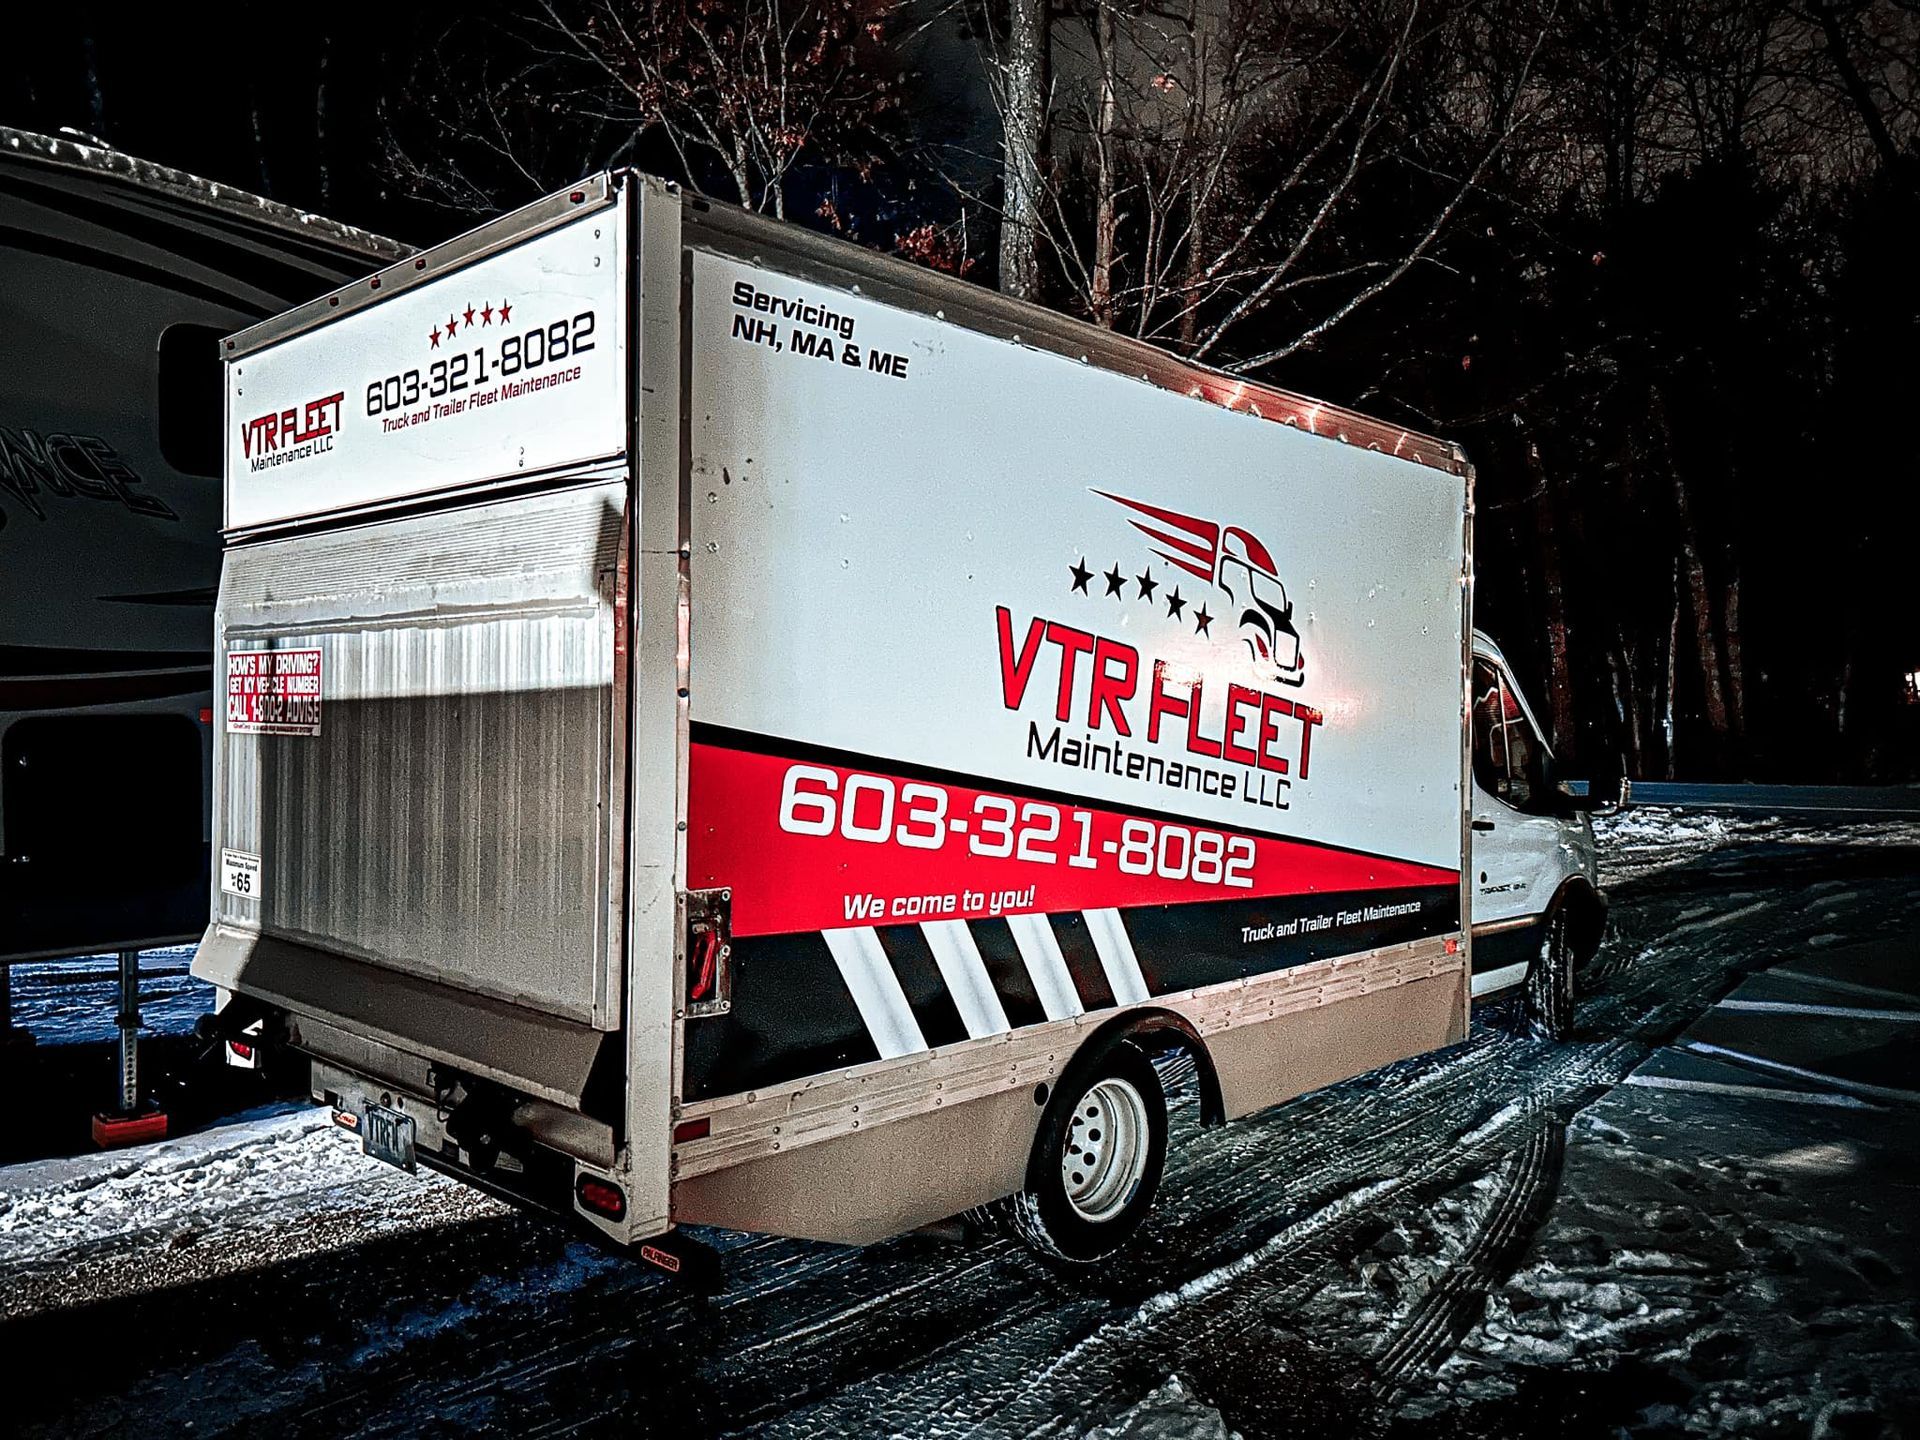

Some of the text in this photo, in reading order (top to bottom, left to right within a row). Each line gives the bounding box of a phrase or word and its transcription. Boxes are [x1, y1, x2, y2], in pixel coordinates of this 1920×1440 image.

[732, 281, 855, 340] Servicing
[366, 310, 595, 417] 603-321-8082
[732, 313, 909, 379] NH, MA & ME
[241, 391, 344, 459] VTR FLEET
[381, 365, 582, 433] Truck and Trailer Fleet Maintenance
[251, 435, 333, 473] Maintenance LLC
[229, 653, 319, 675] HOW'S MY DRIVING?
[287, 675, 319, 693] NUMBER
[996, 605, 1323, 780] VTR FLEET
[229, 695, 249, 721] CALL
[286, 695, 319, 723] ADVISE
[1026, 721, 1292, 811] Maintenance LLC
[778, 763, 1257, 888] 603-321-8082
[237, 872, 251, 893] 65
[843, 884, 1036, 921] We come to you!
[1241, 901, 1422, 943] Truck and Trailer Fleet Maintenance
